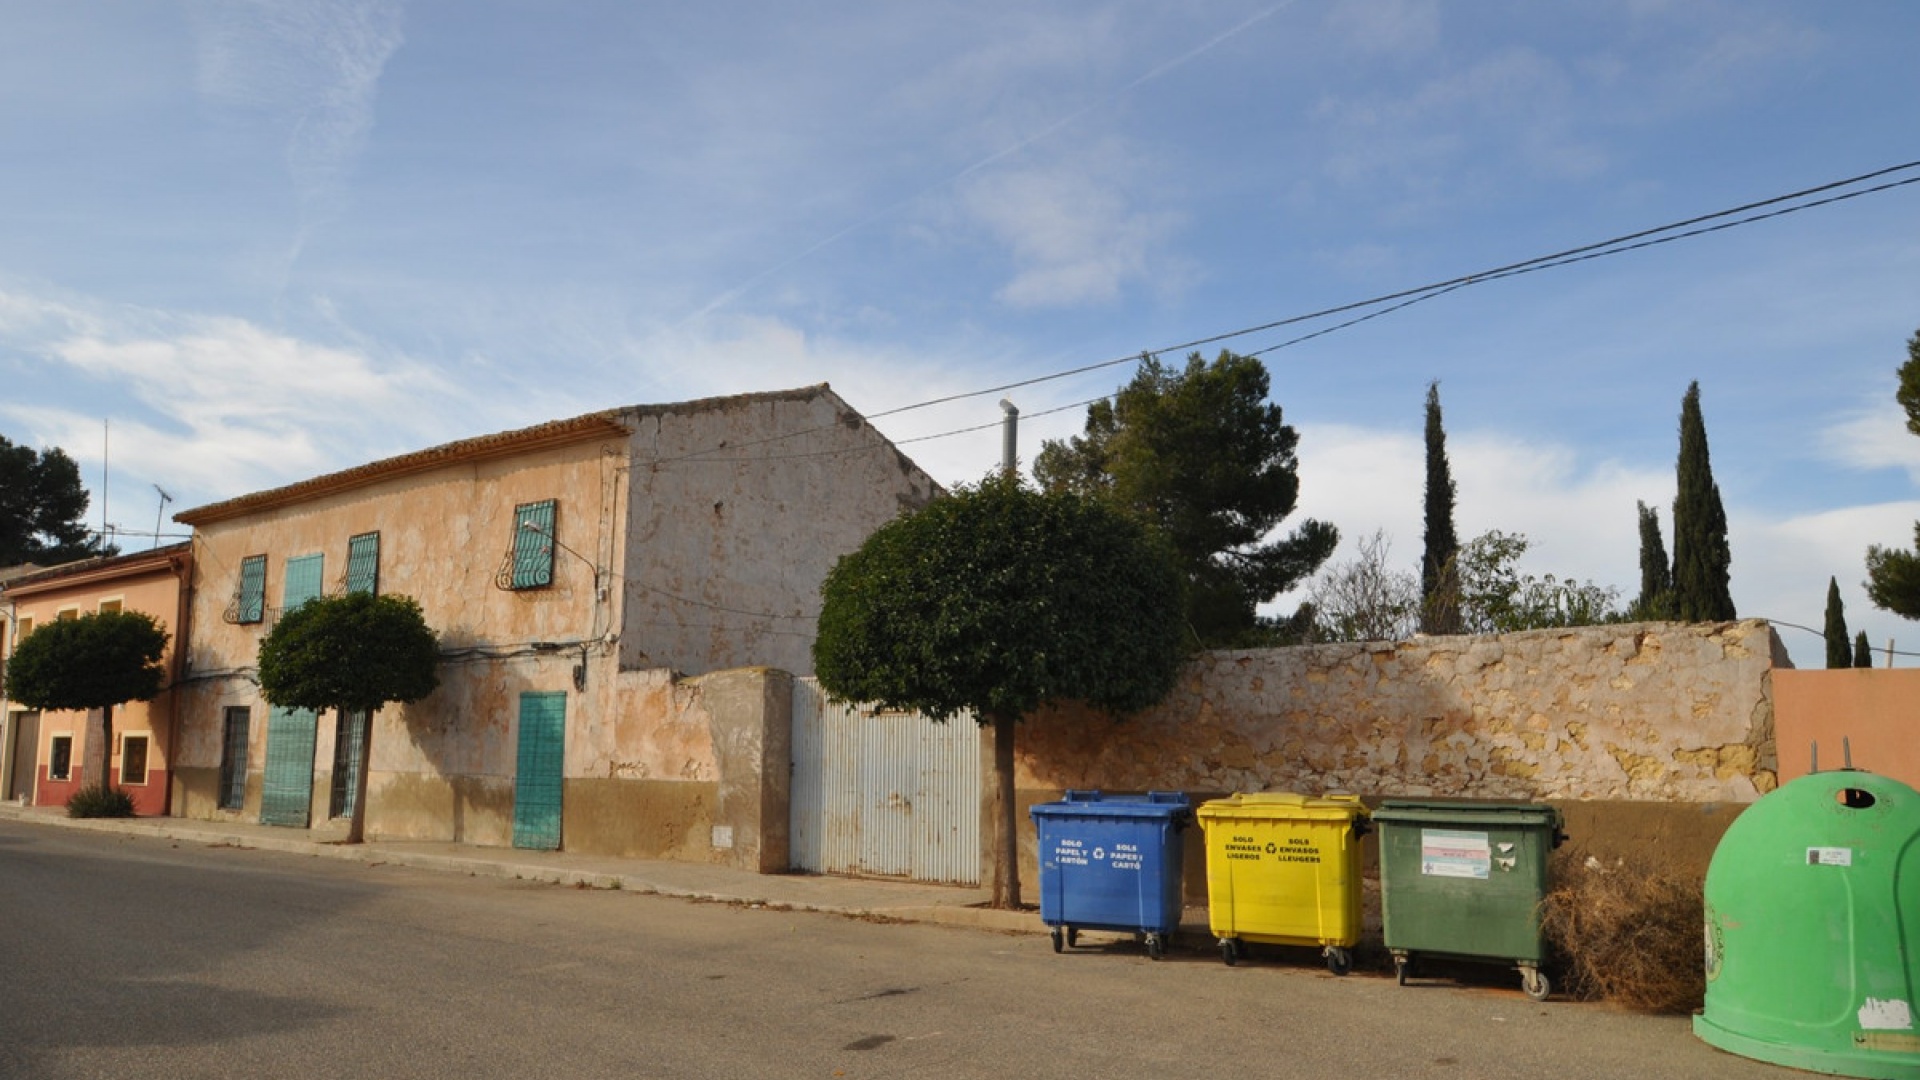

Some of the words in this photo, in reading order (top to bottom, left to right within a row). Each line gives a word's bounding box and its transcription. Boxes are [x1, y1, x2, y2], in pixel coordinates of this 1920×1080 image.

[1061, 839, 1082, 848] SOLO
[1055, 847, 1080, 856] PAPEL
[1081, 849, 1088, 857] Y
[1279, 846, 1319, 854] ENVASOS
